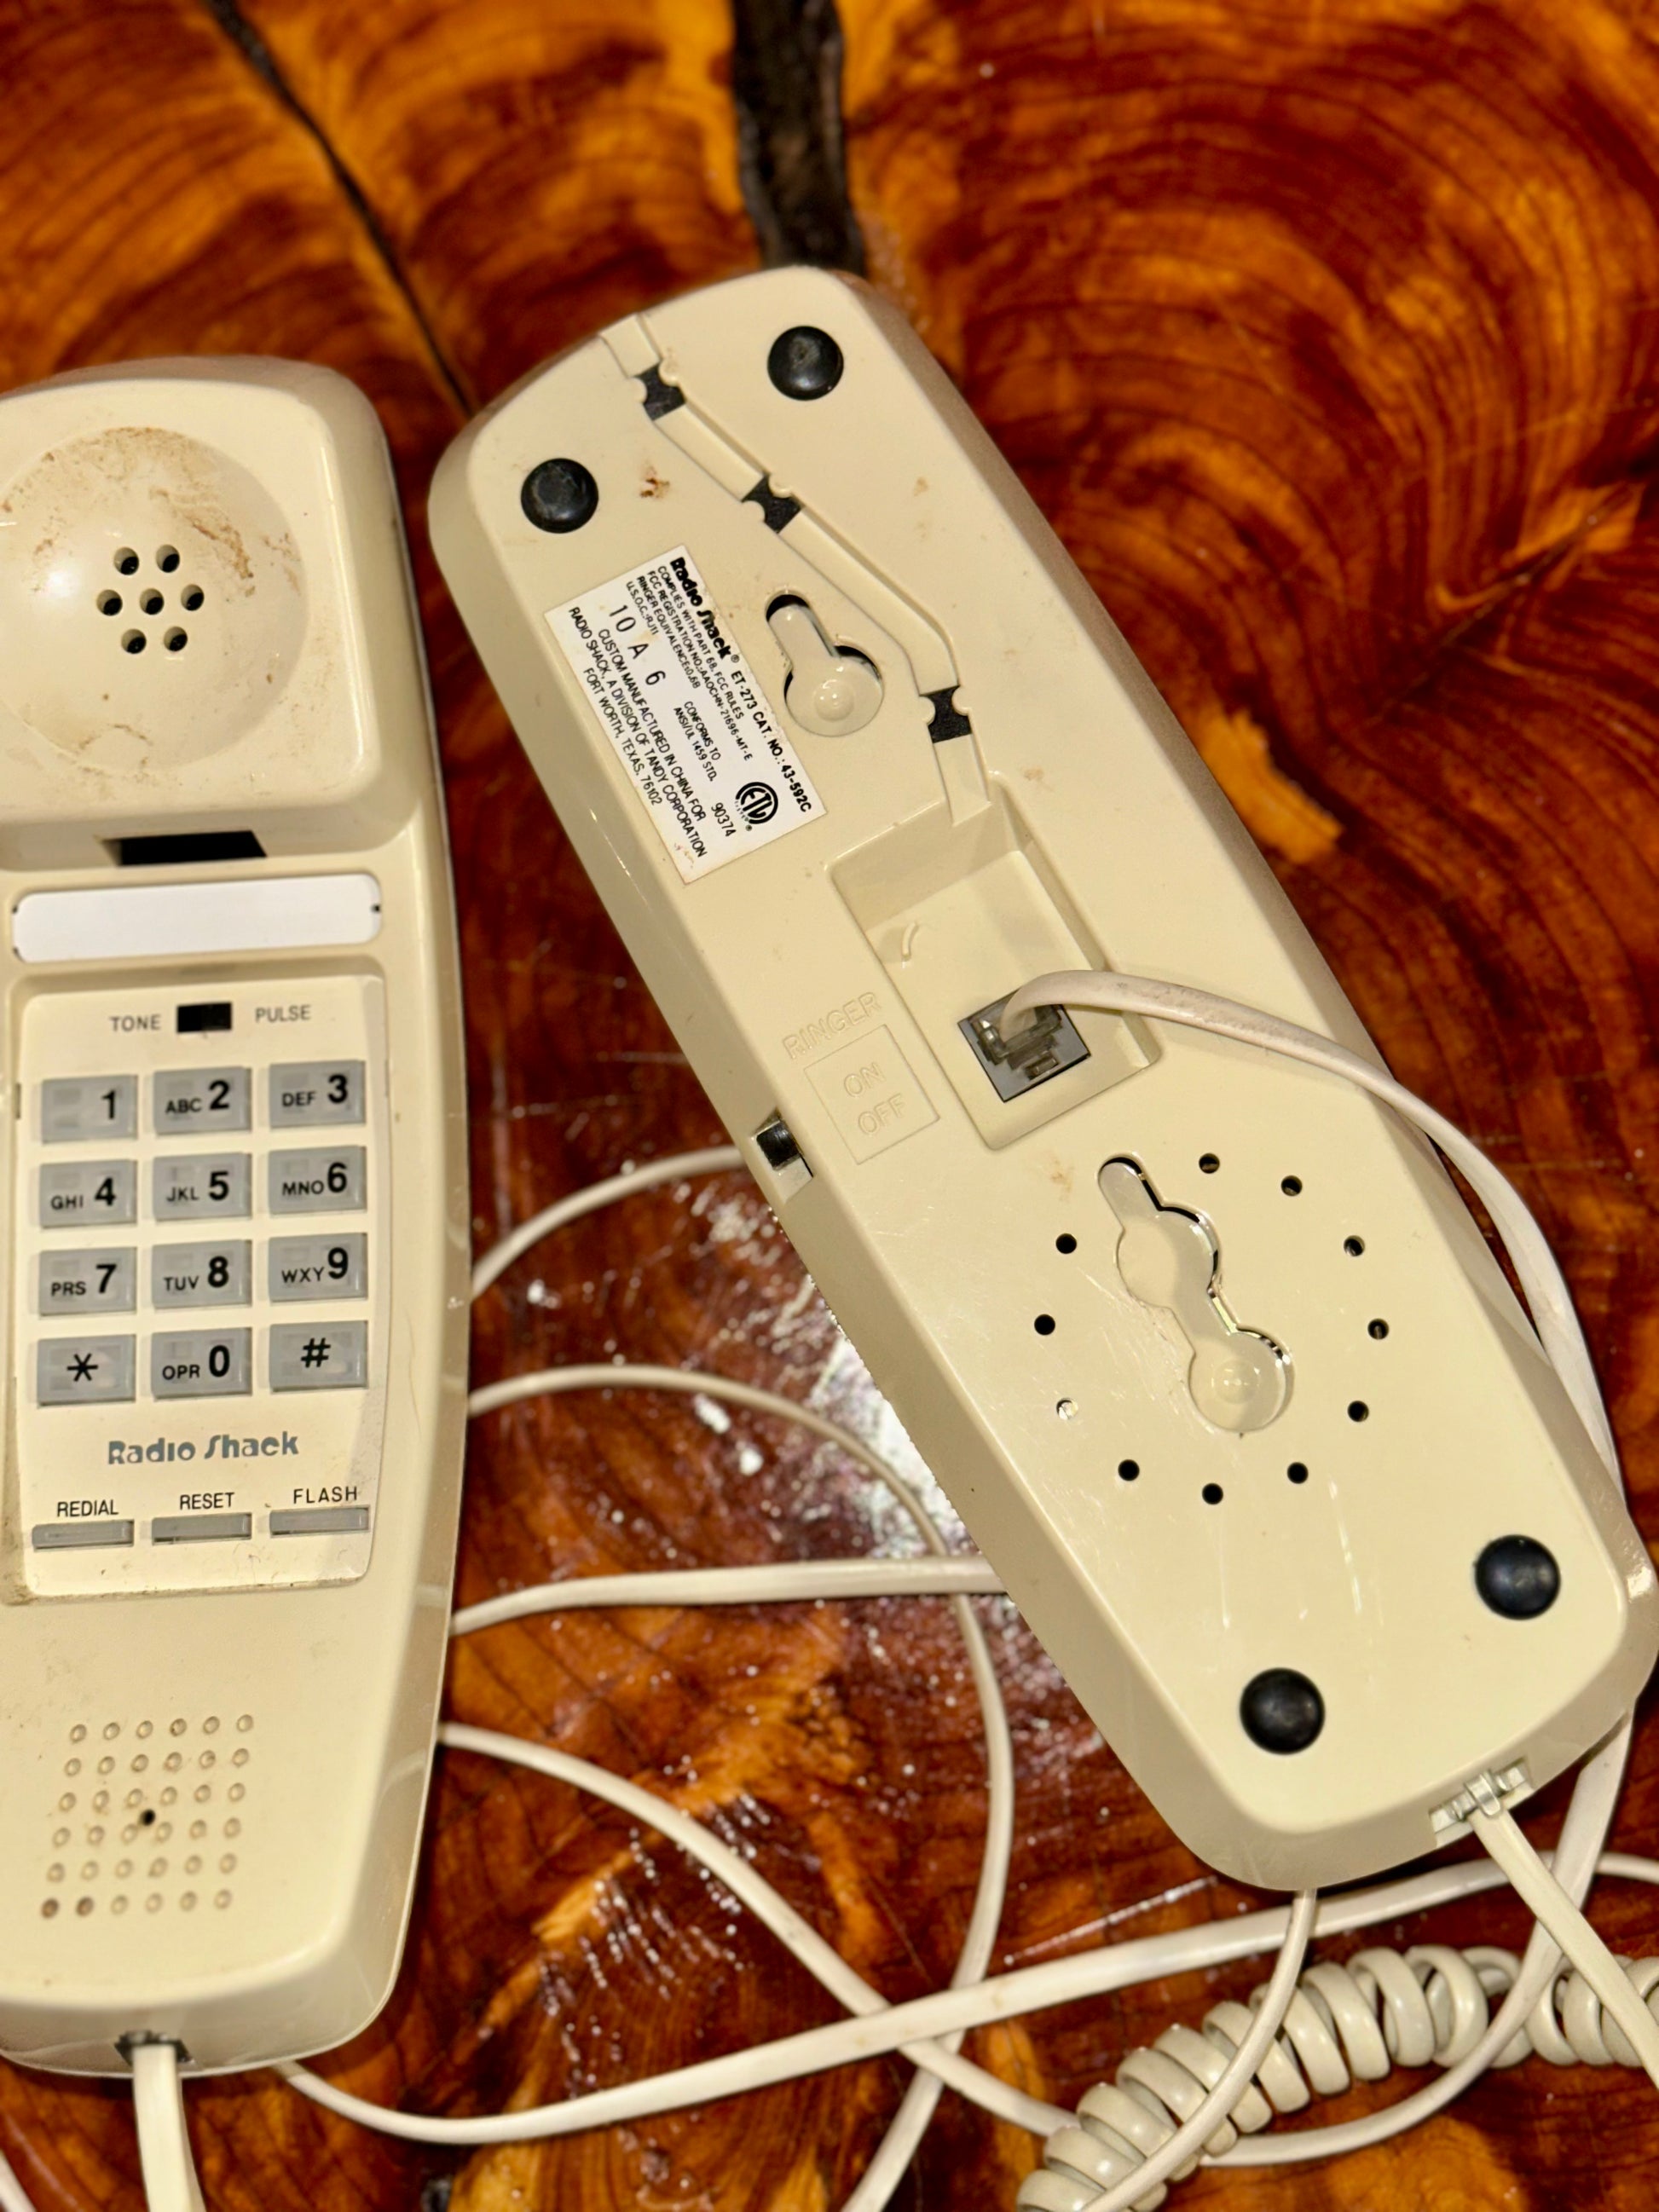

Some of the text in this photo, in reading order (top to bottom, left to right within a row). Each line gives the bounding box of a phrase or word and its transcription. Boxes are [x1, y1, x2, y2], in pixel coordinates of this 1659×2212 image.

[635, 575, 659, 609] RINGER
[568, 605, 593, 639] RADIO
[646, 569, 662, 590] FCC
[656, 588, 696, 653] REGISTRATION
[608, 604, 667, 686] 10 A 6
[656, 564, 685, 609] COMPLIES
[680, 608, 698, 632] WITH
[692, 631, 711, 656] PART
[713, 670, 729, 691] FCC
[723, 690, 745, 720] RULES
[605, 679, 618, 689] A
[668, 555, 703, 608] Radio
[730, 669, 758, 710] ET-273
[751, 710, 772, 738] CAT.
[780, 764, 812, 813] 43-592C
[597, 627, 707, 822] CUSTOM MANUFACTURED IN CHINA FOR
[610, 686, 642, 733] DIVISION
[582, 667, 605, 695] FORT
[639, 774, 663, 806] 76102
[633, 731, 650, 746] OF
[672, 706, 696, 740] ANSI/UL
[691, 739, 708, 761] 1459
[683, 700, 721, 760] CONFORMS TO
[643, 747, 669, 783] TANDY
[661, 783, 708, 858] CORPORATION
[709, 801, 737, 837] 90374
[110, 1015, 162, 1032] TONE
[255, 1006, 311, 1023] PULSE
[782, 992, 882, 1060] RINGER
[165, 1080, 230, 1114] ABC 2
[282, 1074, 349, 1106] DEF 3
[844, 1062, 886, 1098] ON
[101, 1089, 117, 1119] 1
[858, 1093, 905, 1135] OFF
[50, 1177, 117, 1210] GHI 4
[166, 1171, 230, 1202] JKL 5
[281, 1163, 348, 1196] MNO 6
[50, 1264, 118, 1297] PRS 7
[164, 1256, 229, 1291] TUV 8
[281, 1247, 349, 1284] WXY 9
[162, 1345, 231, 1380] OPR 0
[108, 1430, 299, 1464] Radio Shack
[57, 1499, 118, 1517] REDIAL
[179, 1492, 235, 1510] RESET
[293, 1486, 358, 1504] FLASH
